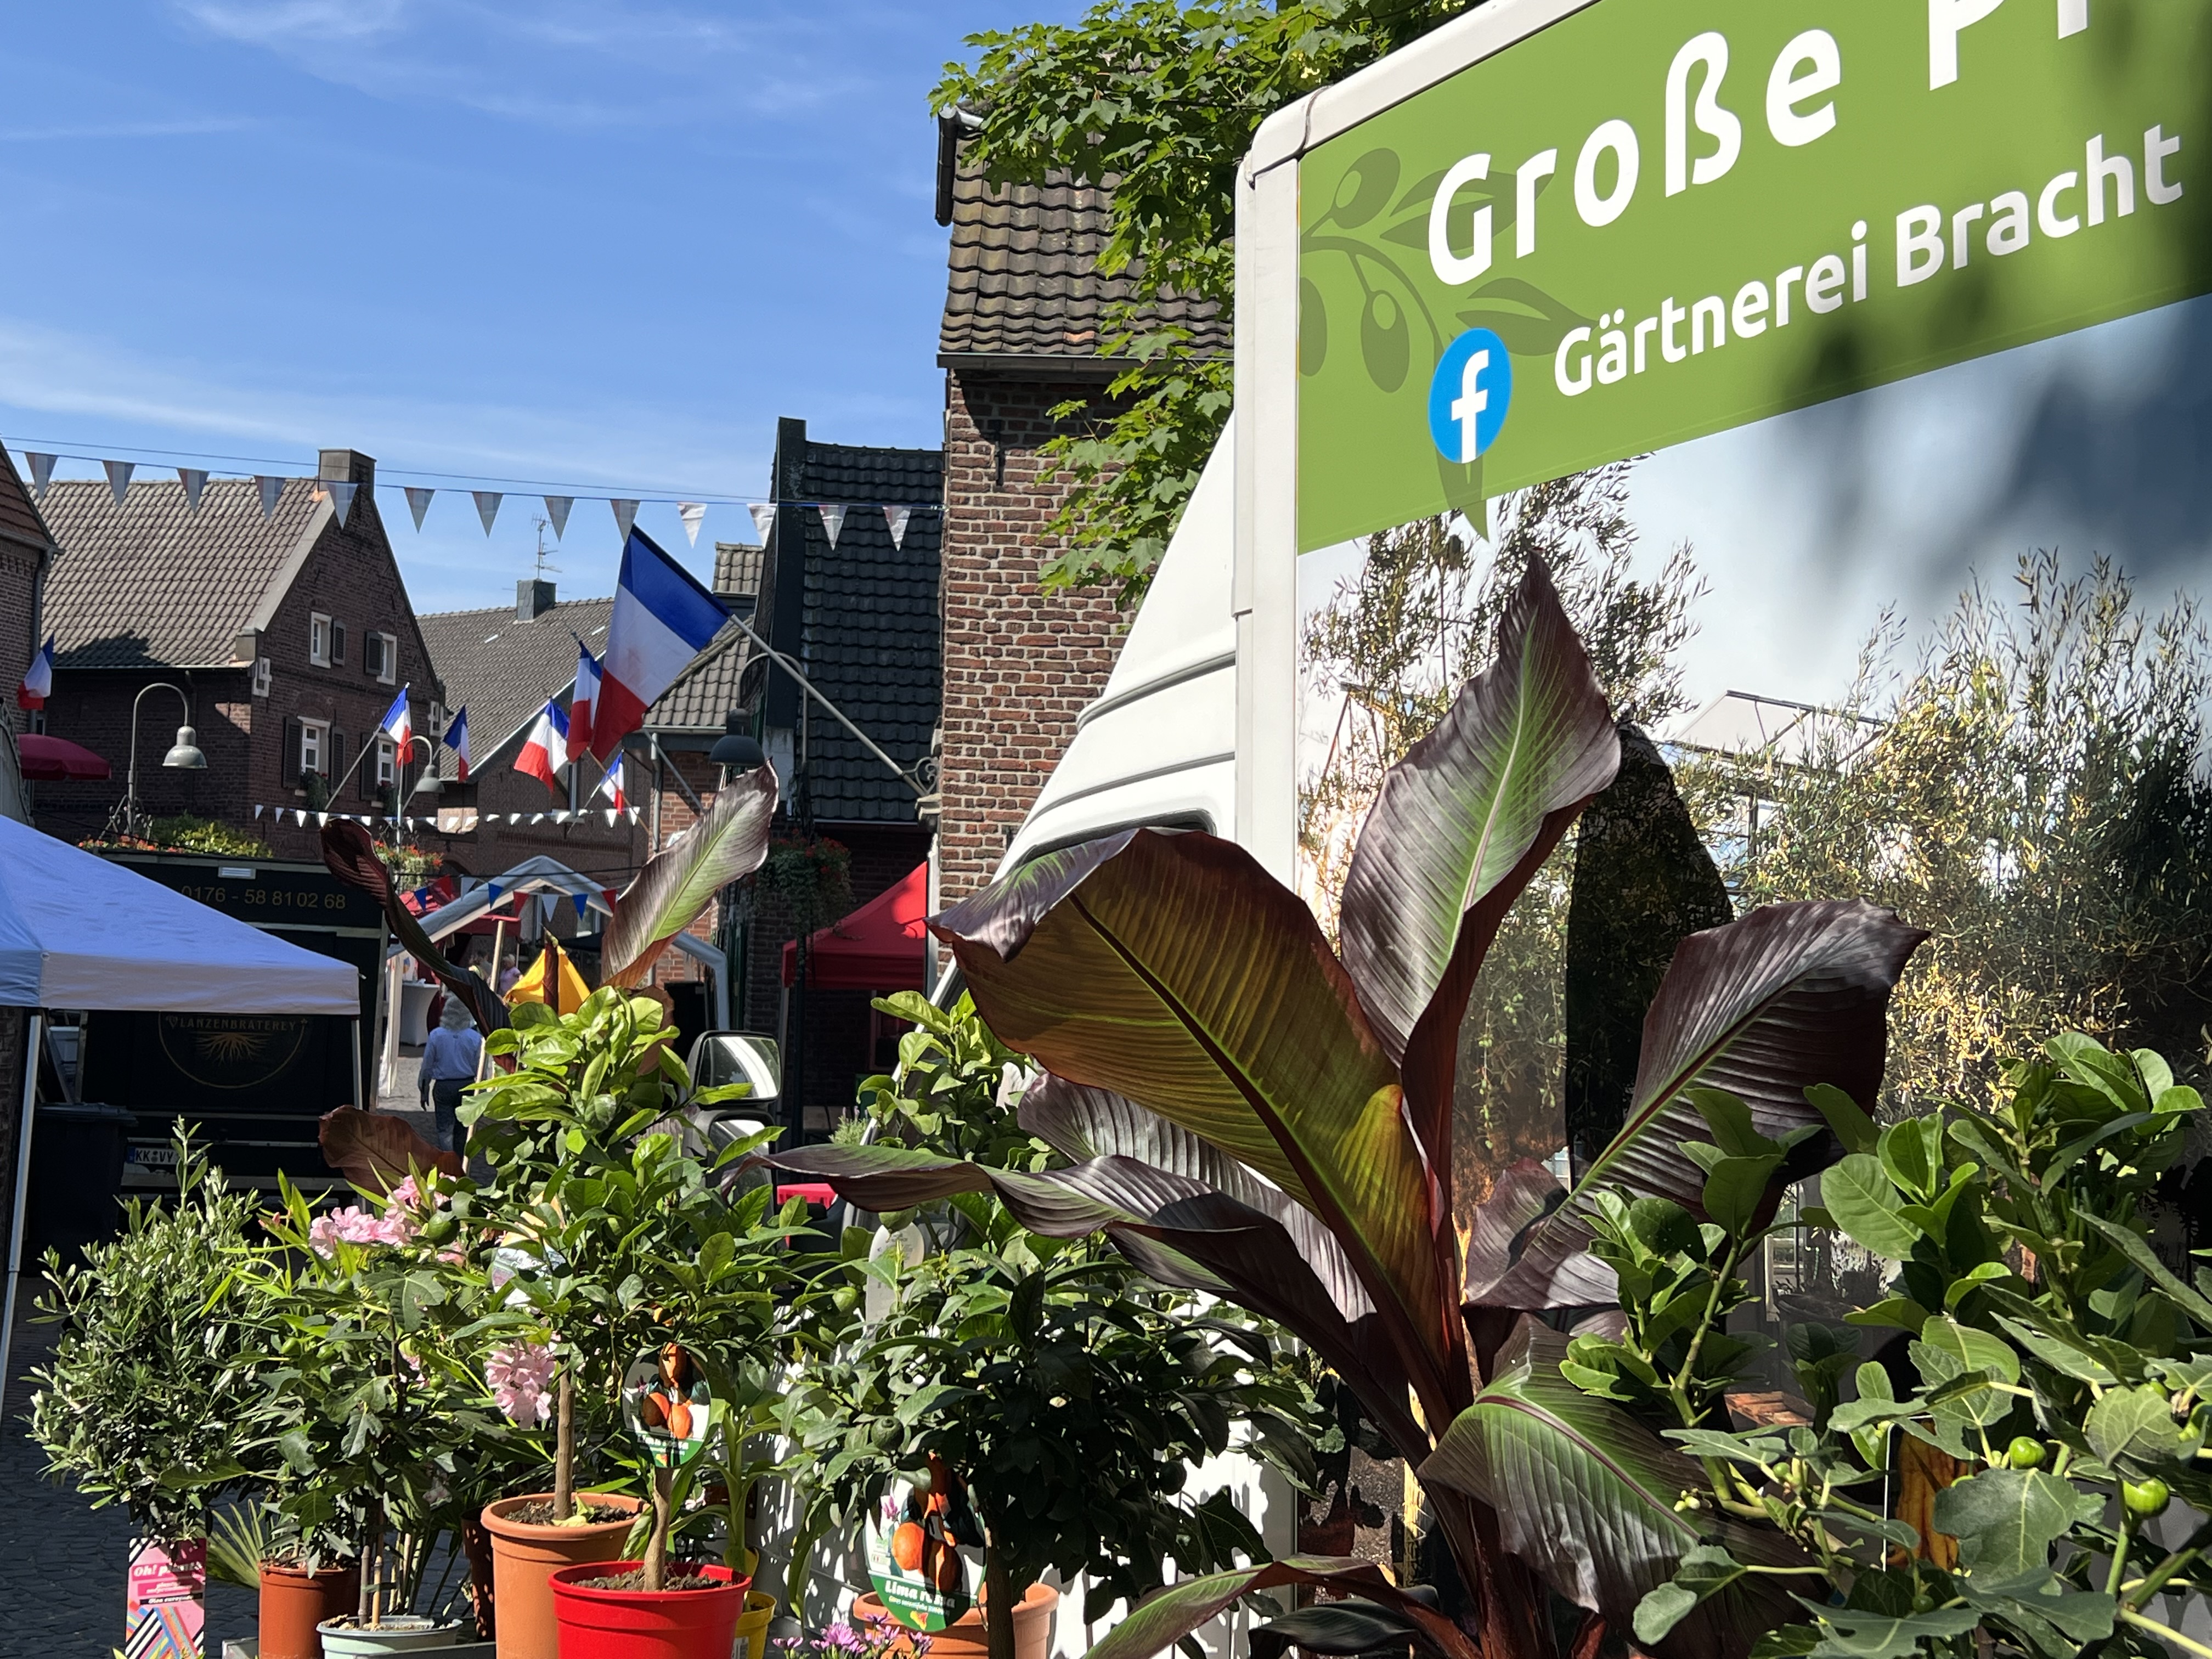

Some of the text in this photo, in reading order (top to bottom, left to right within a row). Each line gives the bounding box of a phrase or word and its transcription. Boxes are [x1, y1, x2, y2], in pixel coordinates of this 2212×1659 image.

[1427, 29, 1841, 286] Große
[1555, 125, 2183, 397] Gärtnerei Bracht
[245, 888, 266, 904] 58
[325, 894, 346, 909] 68
[136, 1149, 150, 1163] KK
[134, 1565, 157, 1577] Oh!
[885, 1580, 918, 1600] Lima
